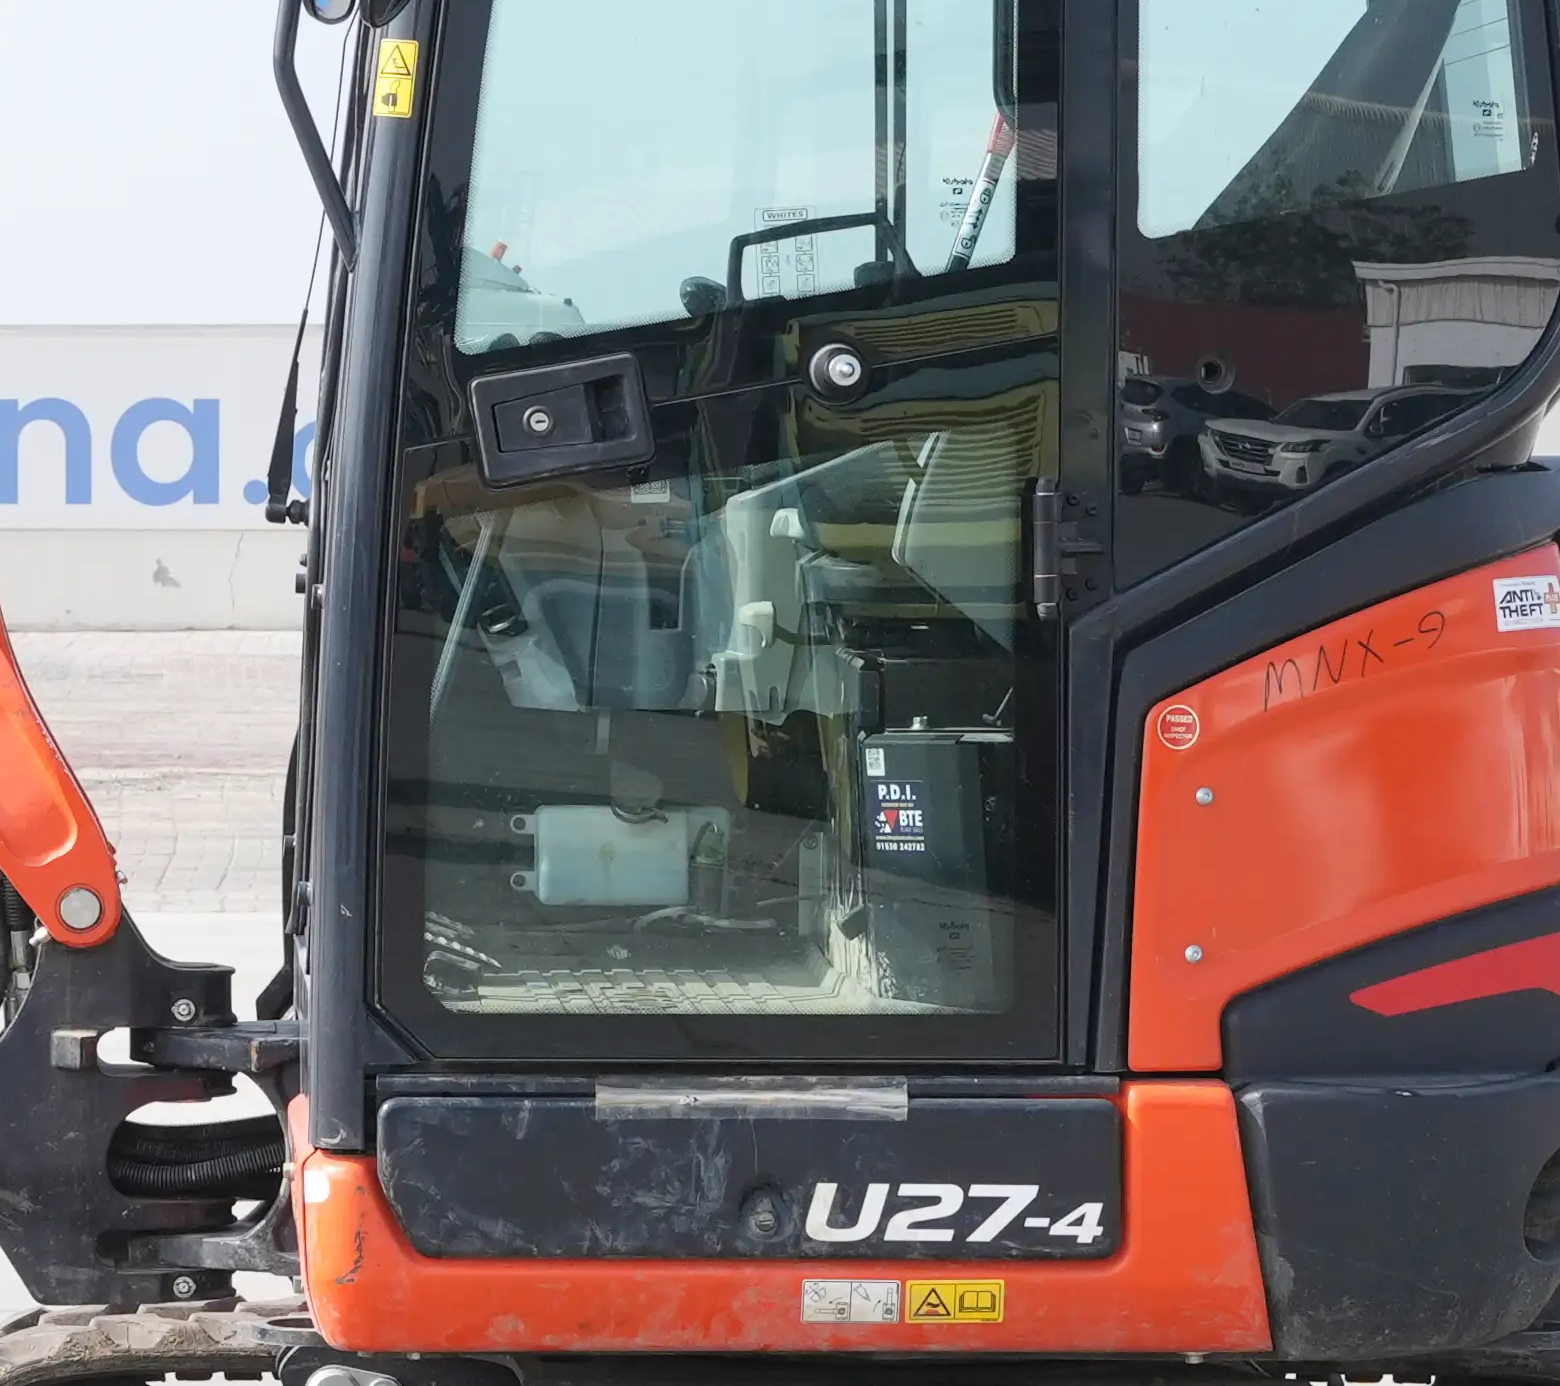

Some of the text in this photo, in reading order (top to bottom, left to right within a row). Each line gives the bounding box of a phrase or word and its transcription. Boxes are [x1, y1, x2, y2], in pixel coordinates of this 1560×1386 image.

[1499, 588, 1535, 605] ANTI
[1499, 602, 1544, 619] THEFT
[877, 783, 917, 801] P.D.I.
[899, 809, 924, 827] BTE
[804, 1182, 1104, 1244] U27-4
